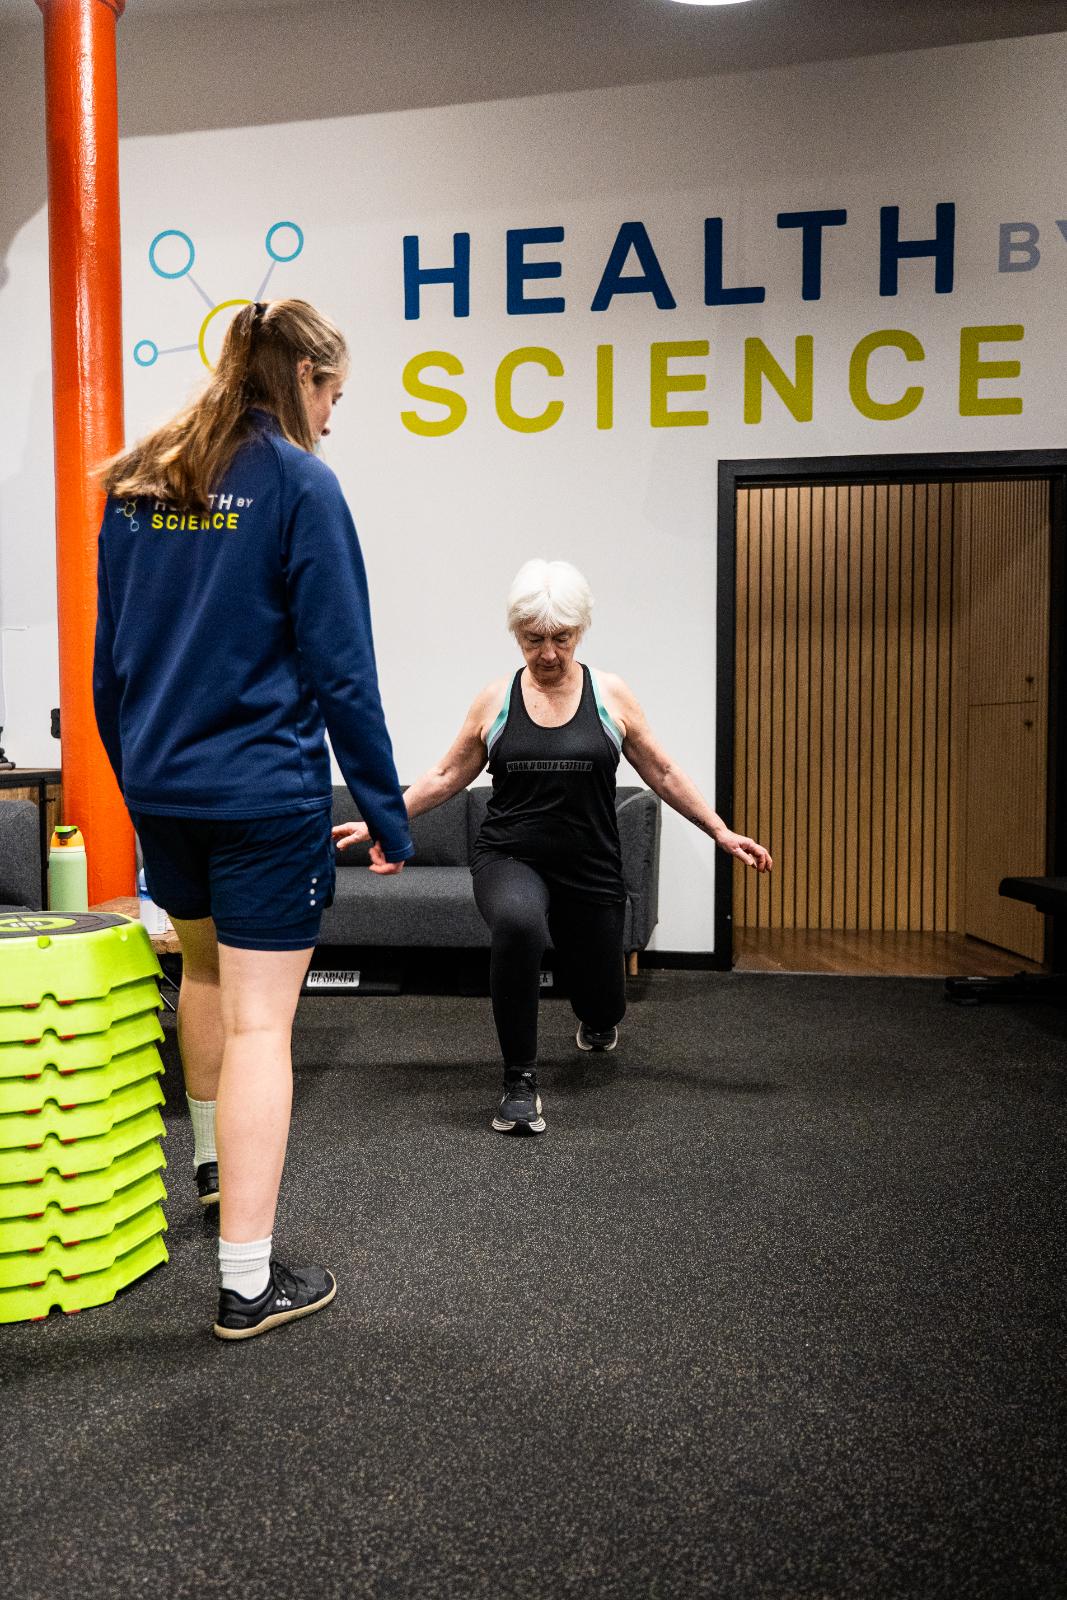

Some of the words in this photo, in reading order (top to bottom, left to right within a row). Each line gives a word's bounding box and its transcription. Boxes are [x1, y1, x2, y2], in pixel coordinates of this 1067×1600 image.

[402, 202, 956, 320] HEALTH
[998, 219, 1067, 273] B
[400, 324, 1025, 437] SCIENCE
[236, 497, 254, 509] BY
